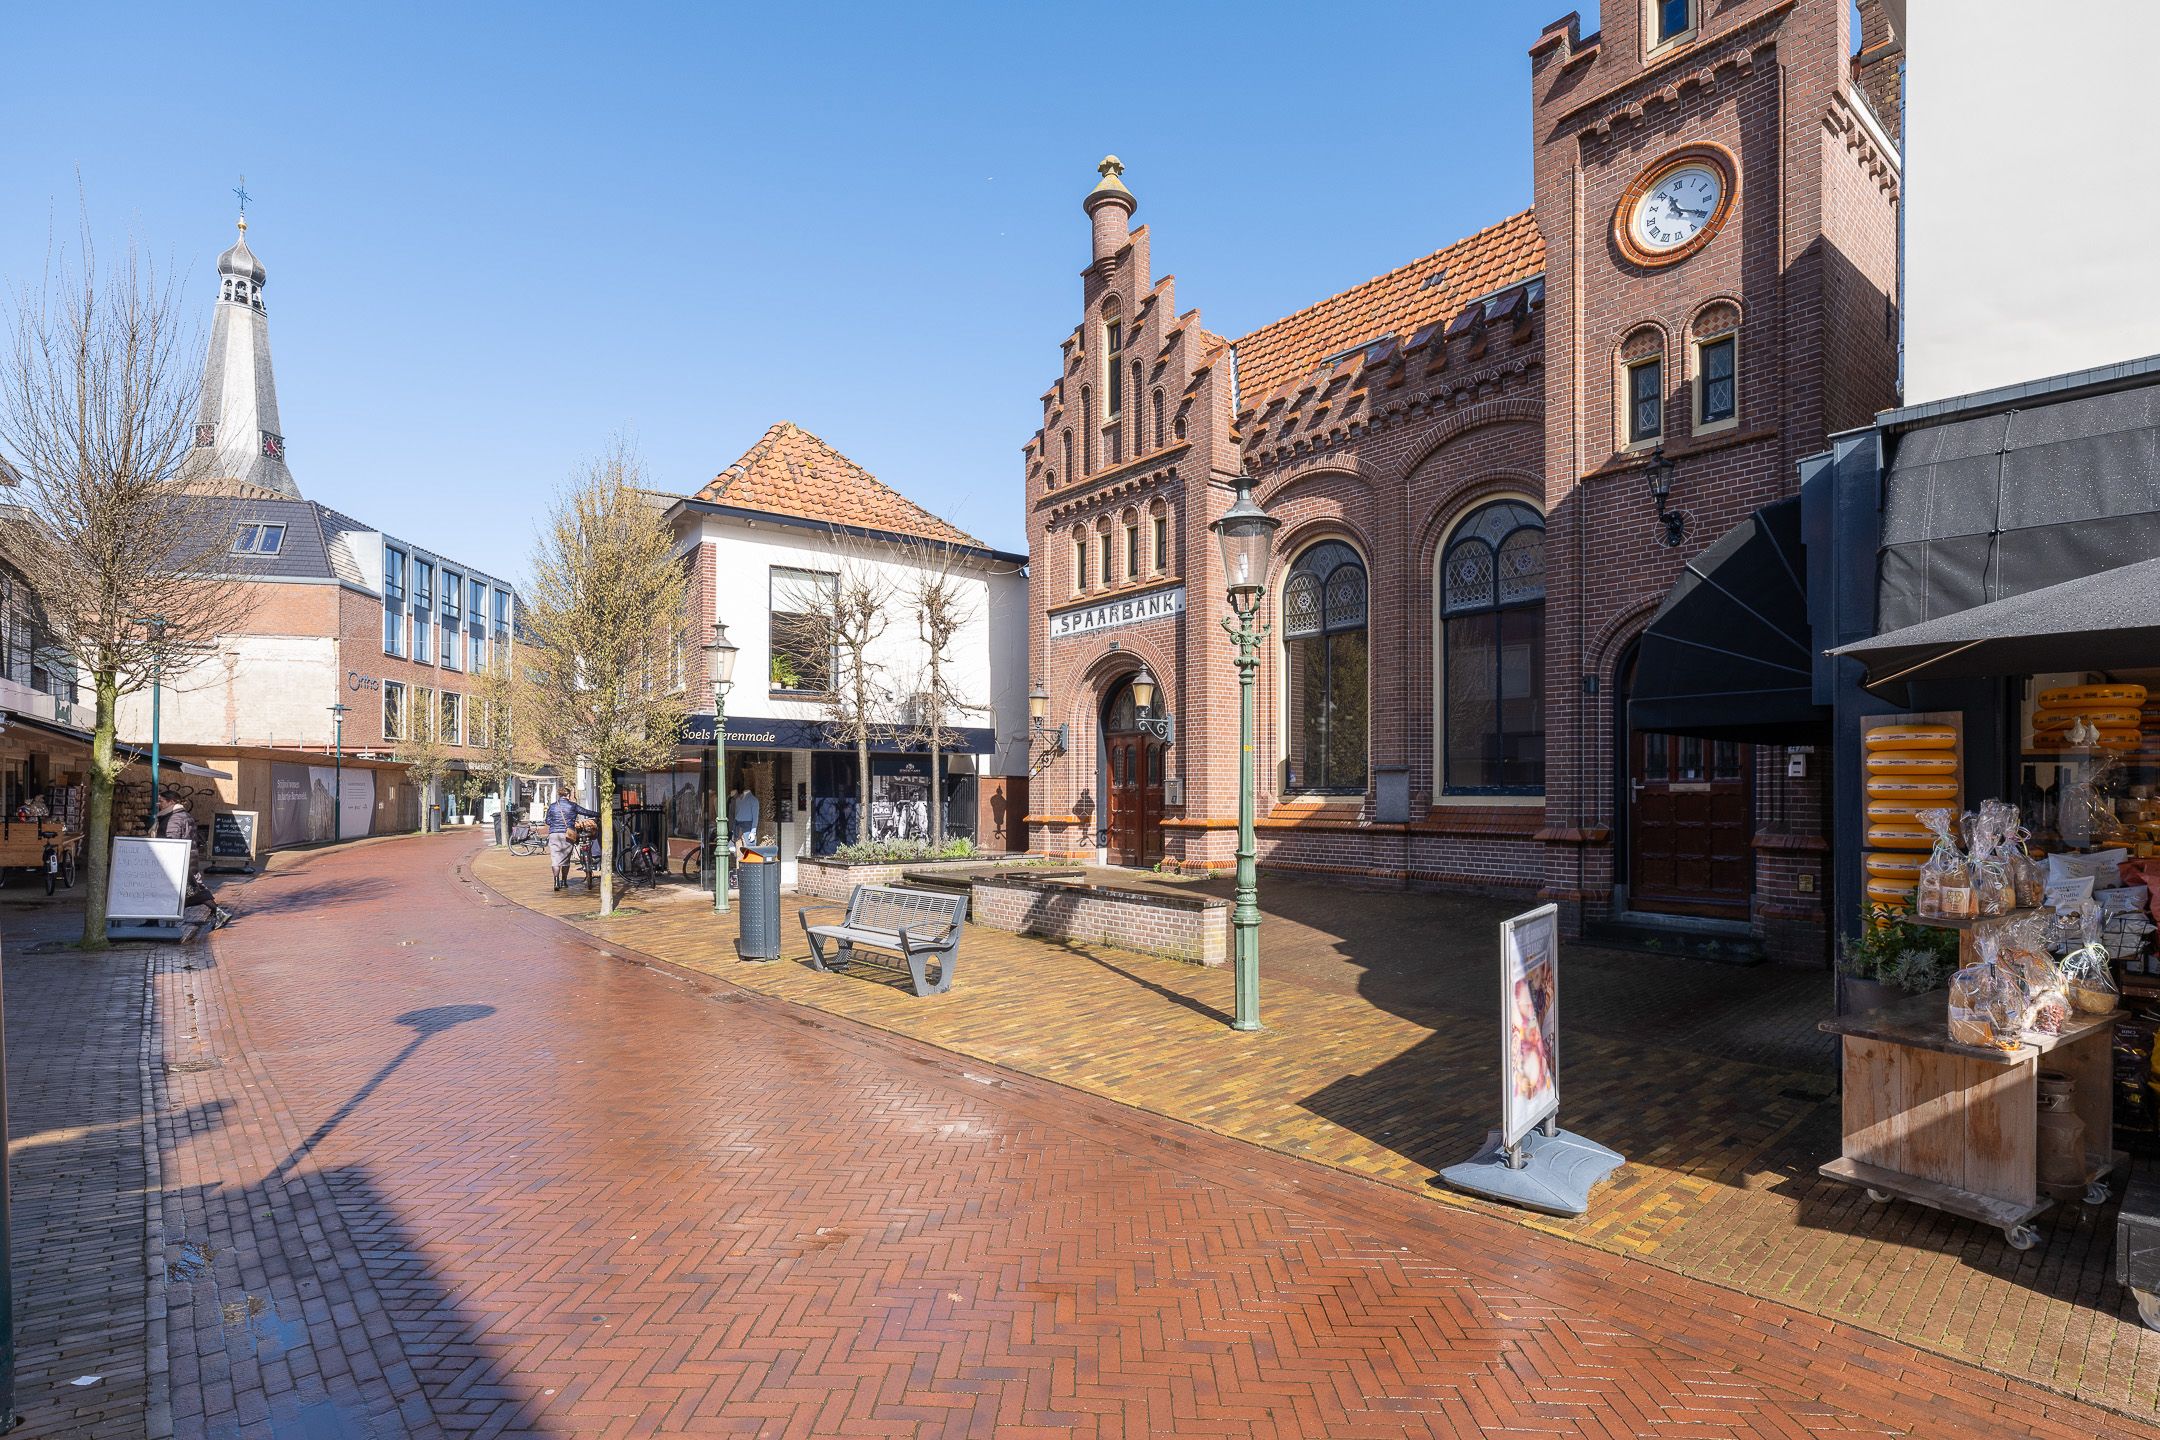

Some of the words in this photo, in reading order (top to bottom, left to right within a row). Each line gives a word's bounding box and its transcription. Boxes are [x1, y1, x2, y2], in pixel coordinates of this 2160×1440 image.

[1673, 180, 1683, 191] XII
[1657, 191, 1668, 202] XI
[1061, 592, 1174, 633] SPAARBANK
[681, 728, 711, 740] Soels
